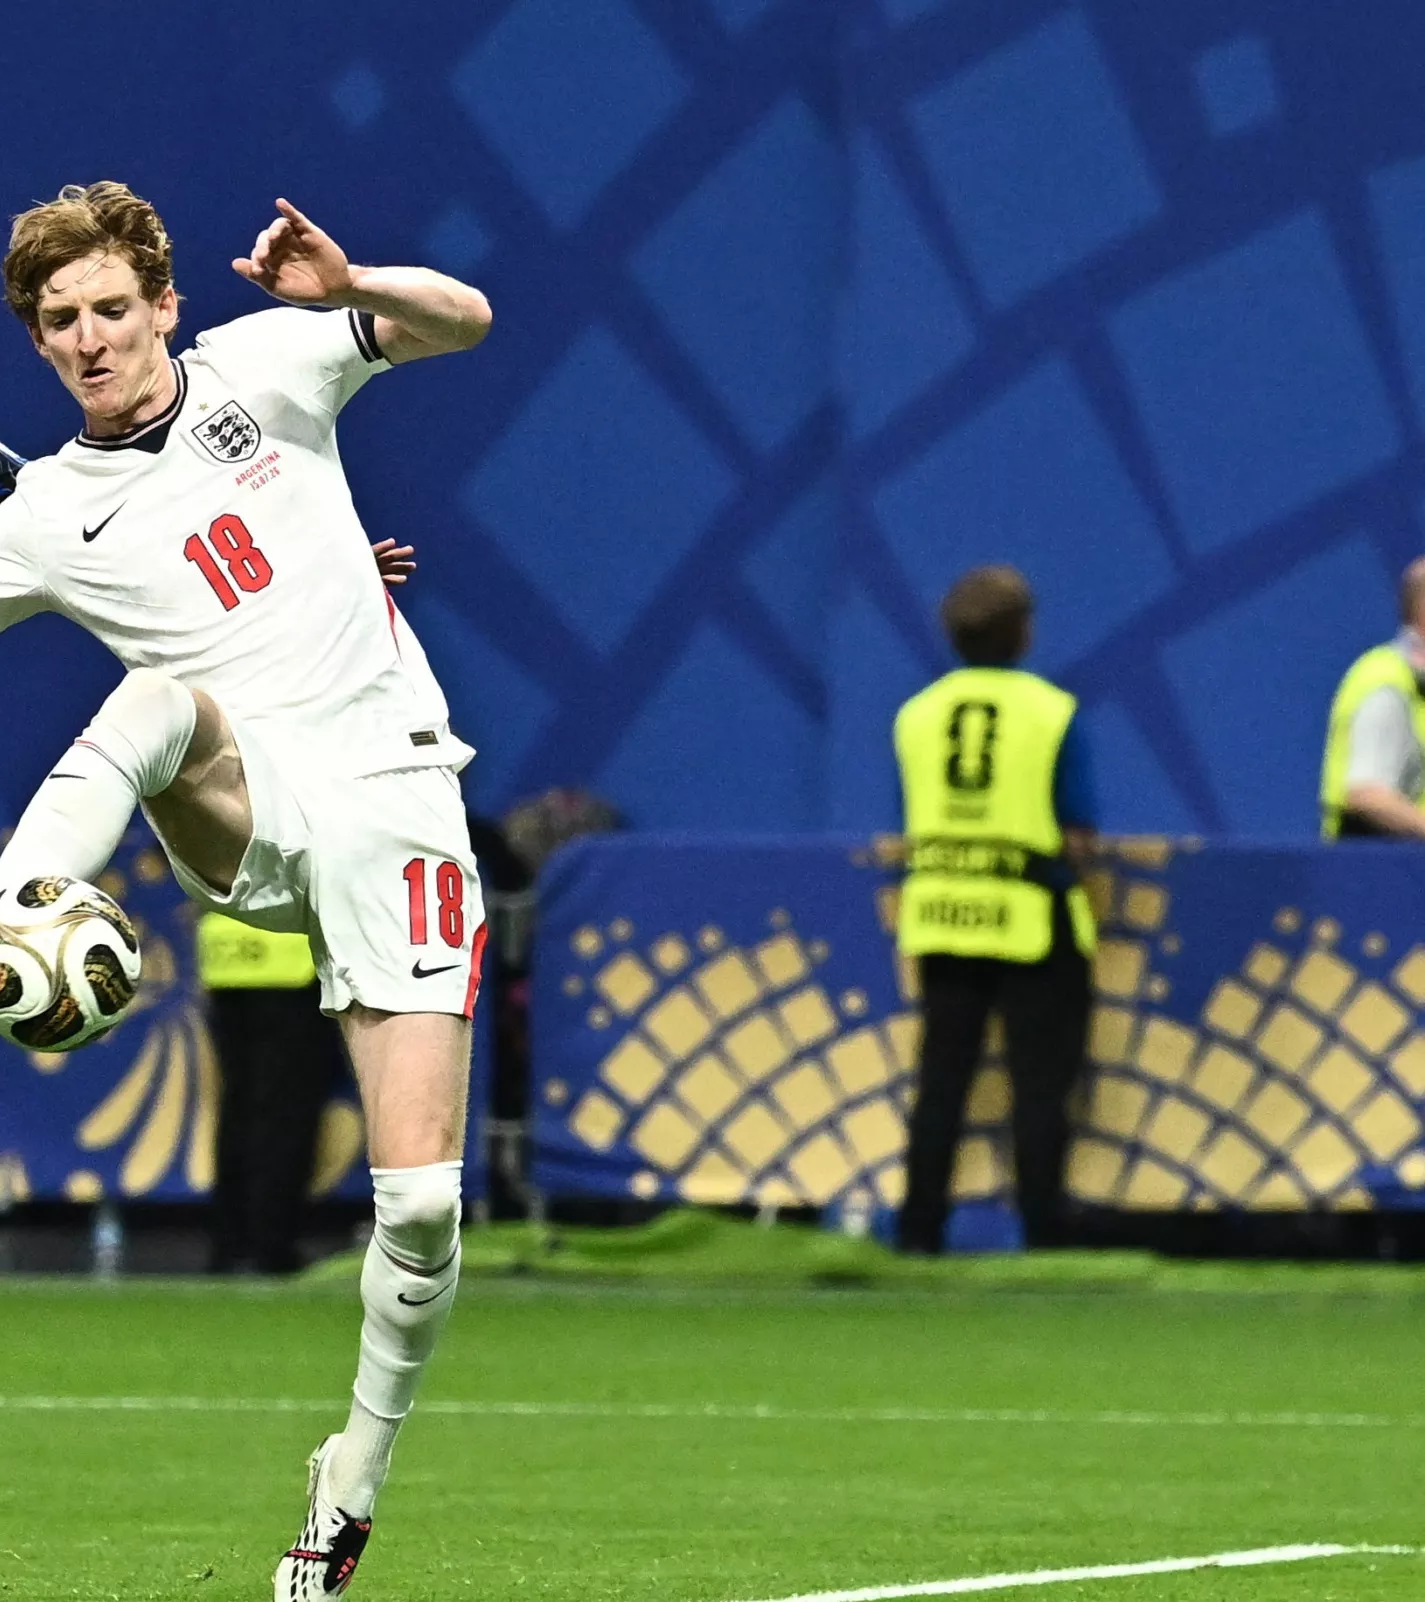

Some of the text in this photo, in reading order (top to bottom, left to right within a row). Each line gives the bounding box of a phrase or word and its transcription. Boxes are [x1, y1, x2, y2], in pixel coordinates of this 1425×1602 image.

[235, 450, 280, 486] ARGENTINA
[250, 466, 280, 491] 15.07.26
[184, 514, 273, 611] 18
[403, 858, 464, 948] 18
